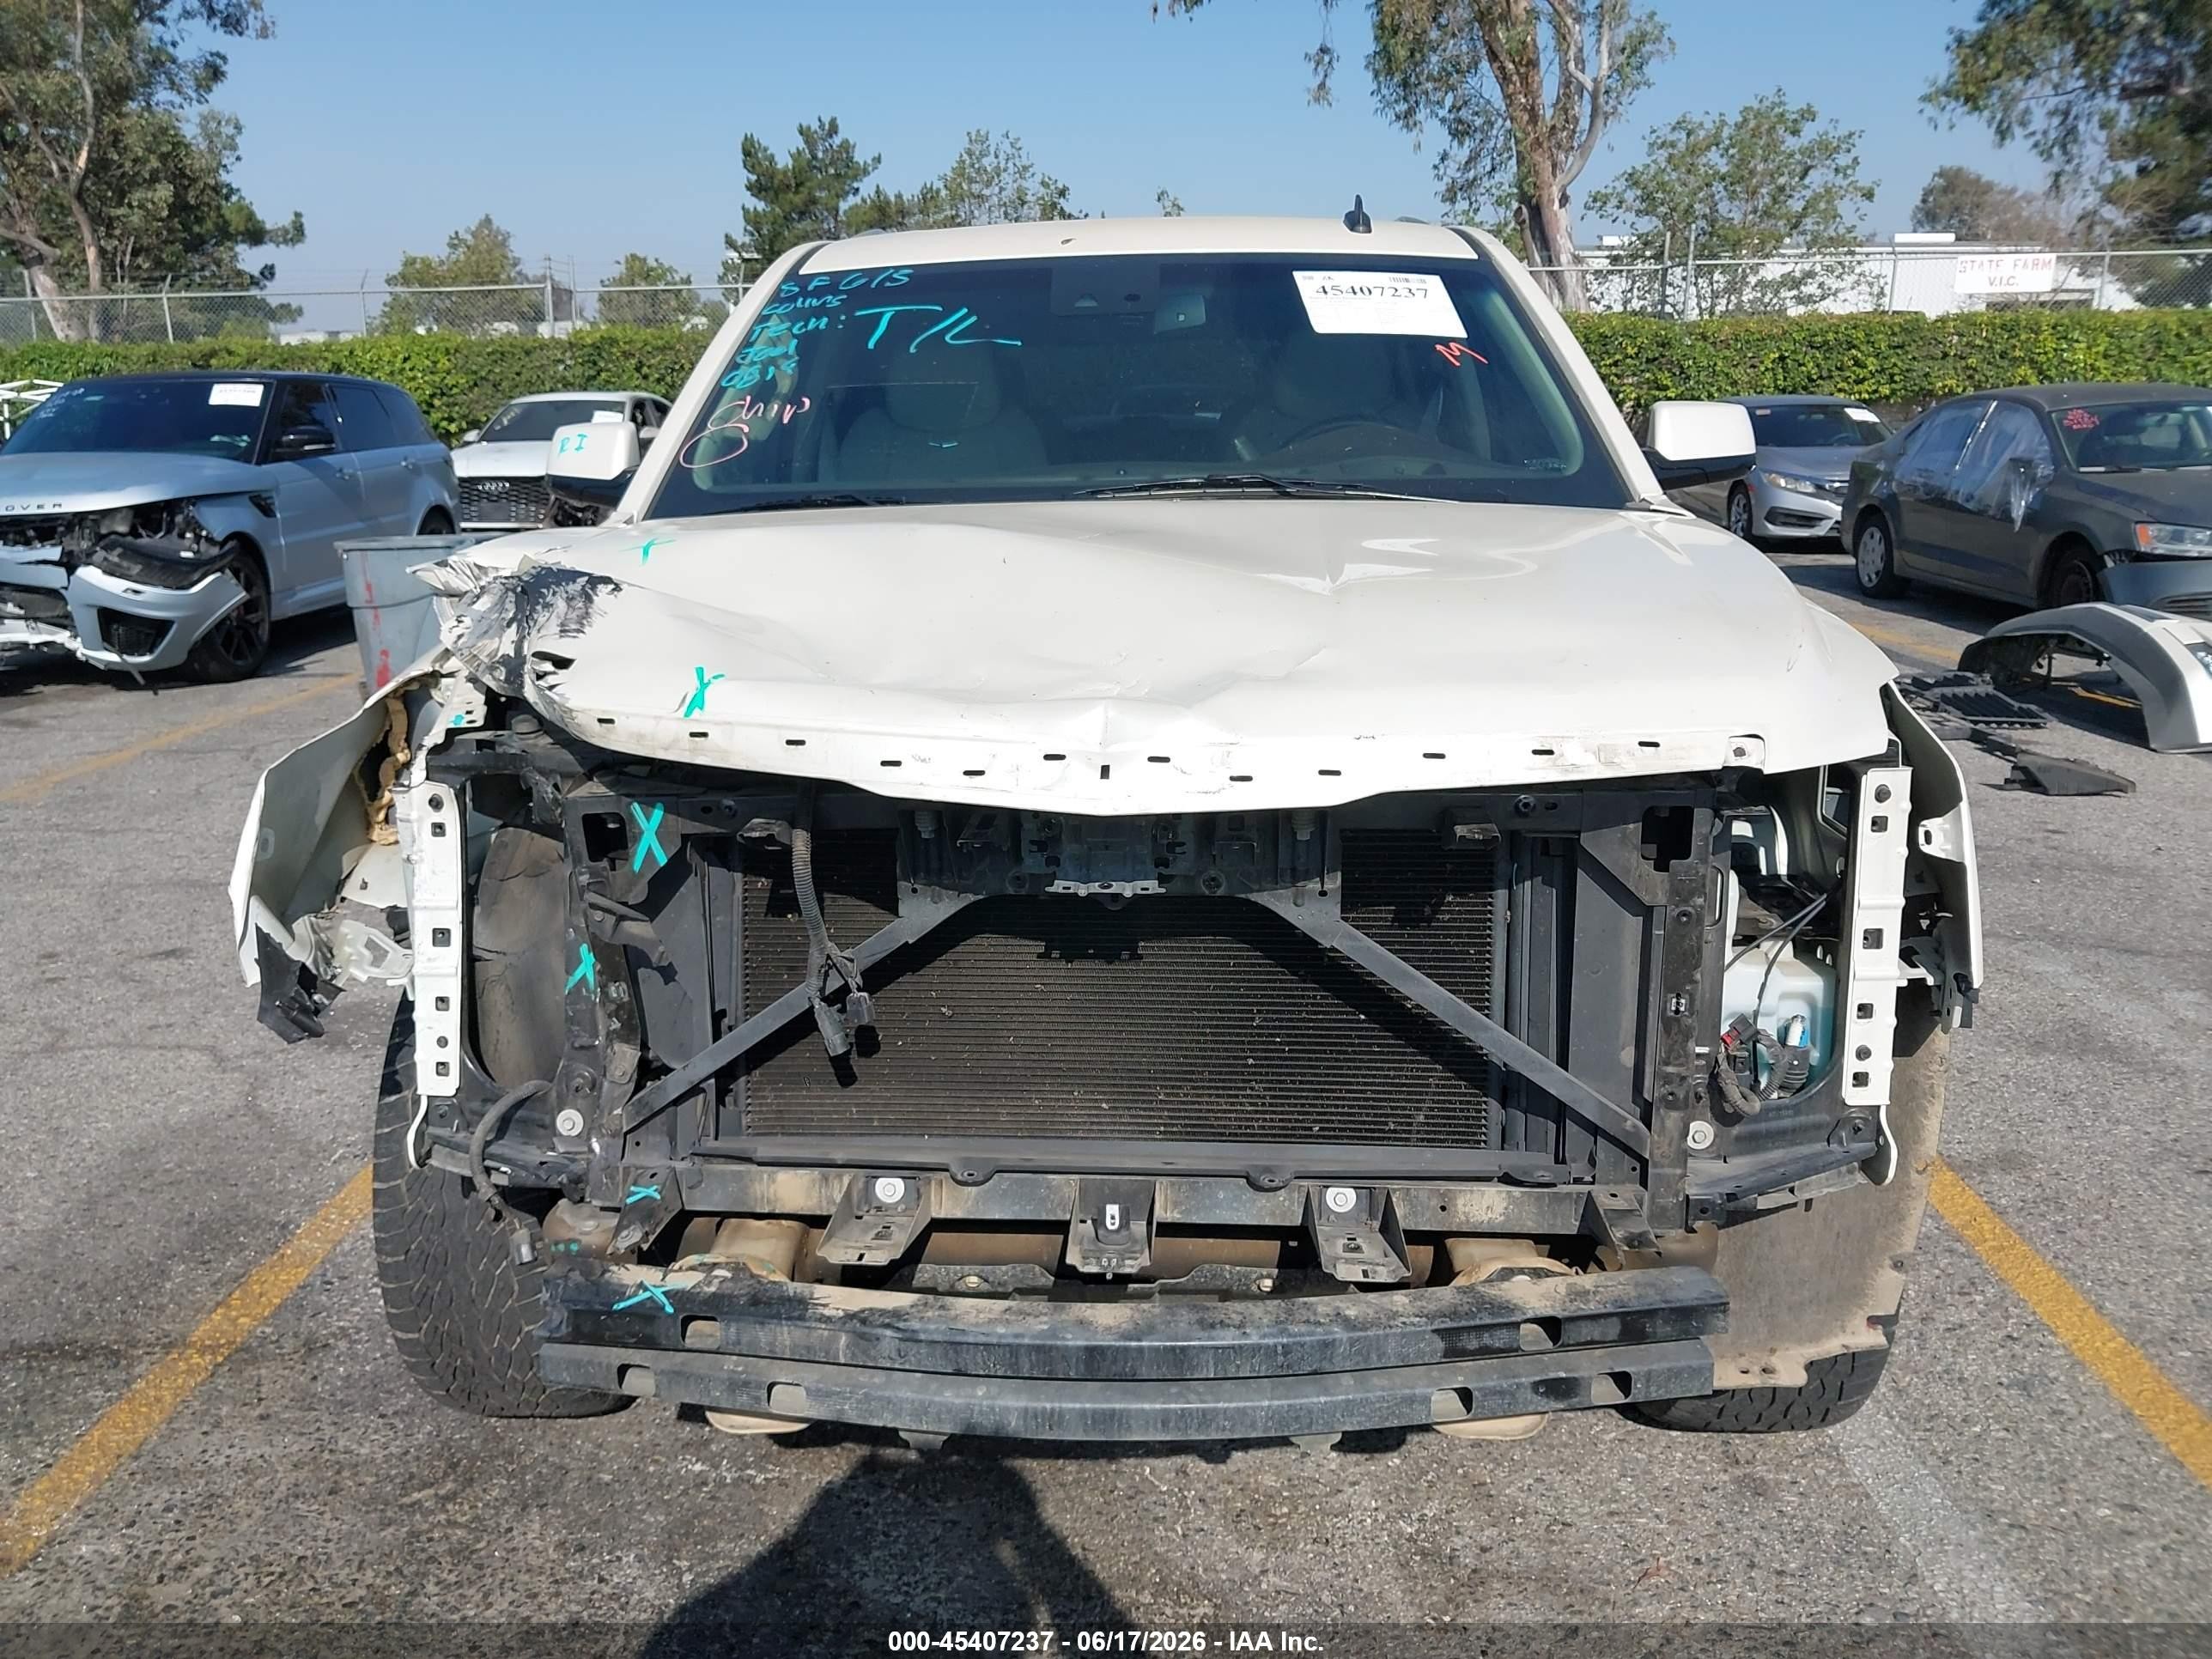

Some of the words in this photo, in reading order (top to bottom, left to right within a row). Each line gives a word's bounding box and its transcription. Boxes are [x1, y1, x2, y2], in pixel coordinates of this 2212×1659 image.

[1959, 259, 2004, 273] STATE
[2013, 258, 2052, 271] FARM
[1988, 276, 2019, 287] V.I.C.
[1316, 284, 1428, 299] 45407237
